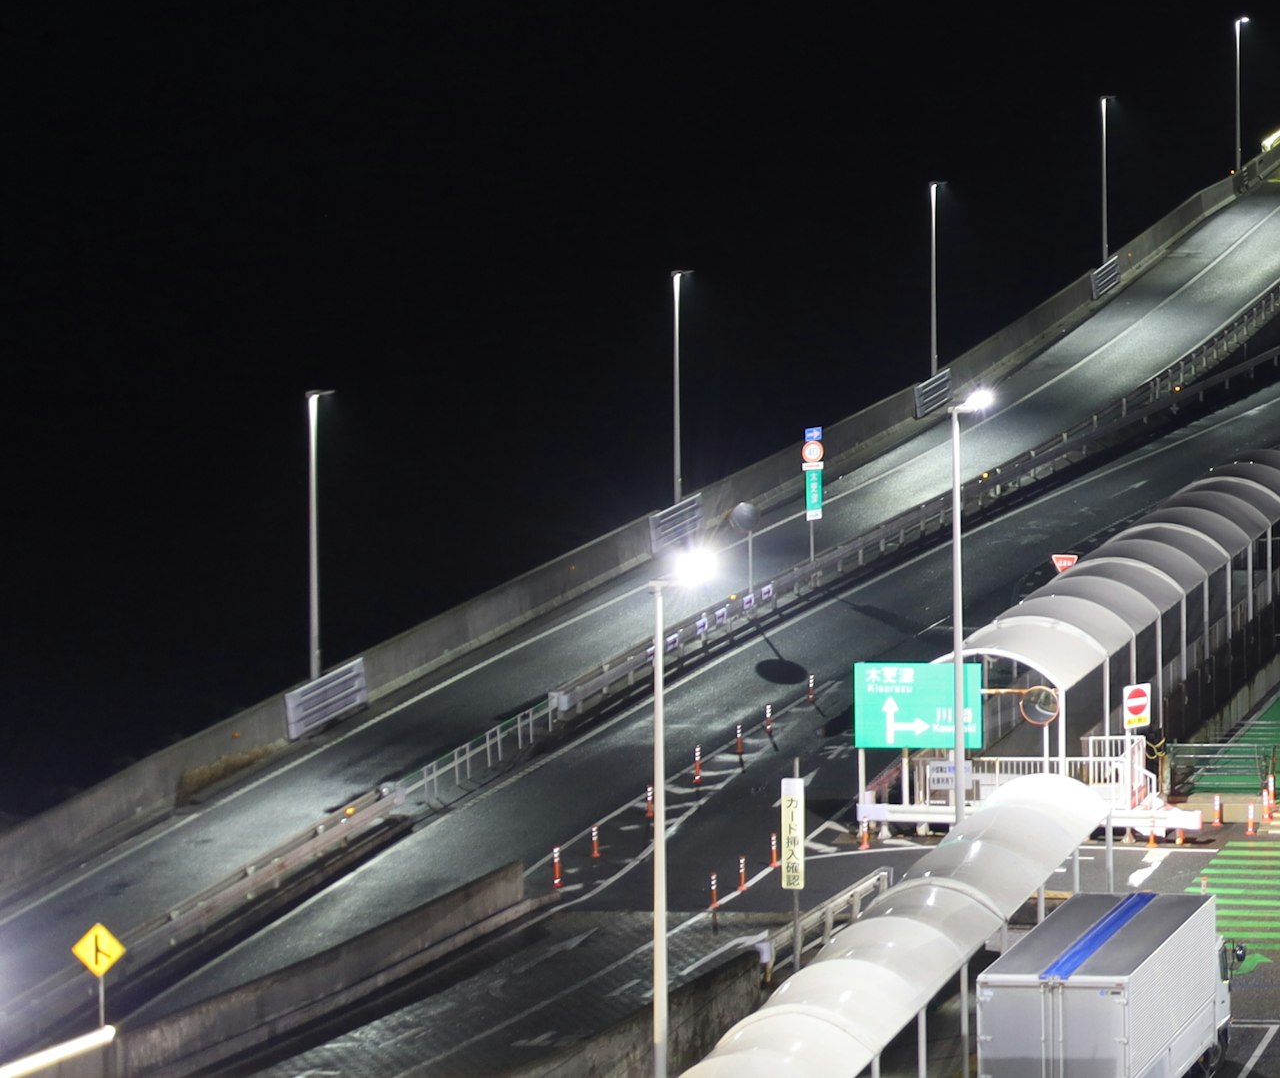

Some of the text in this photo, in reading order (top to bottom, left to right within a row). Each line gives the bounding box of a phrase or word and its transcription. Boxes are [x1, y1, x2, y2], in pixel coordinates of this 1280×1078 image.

[865, 667, 915, 683] 木更津
[785, 798, 801, 887] カード挿入確認
